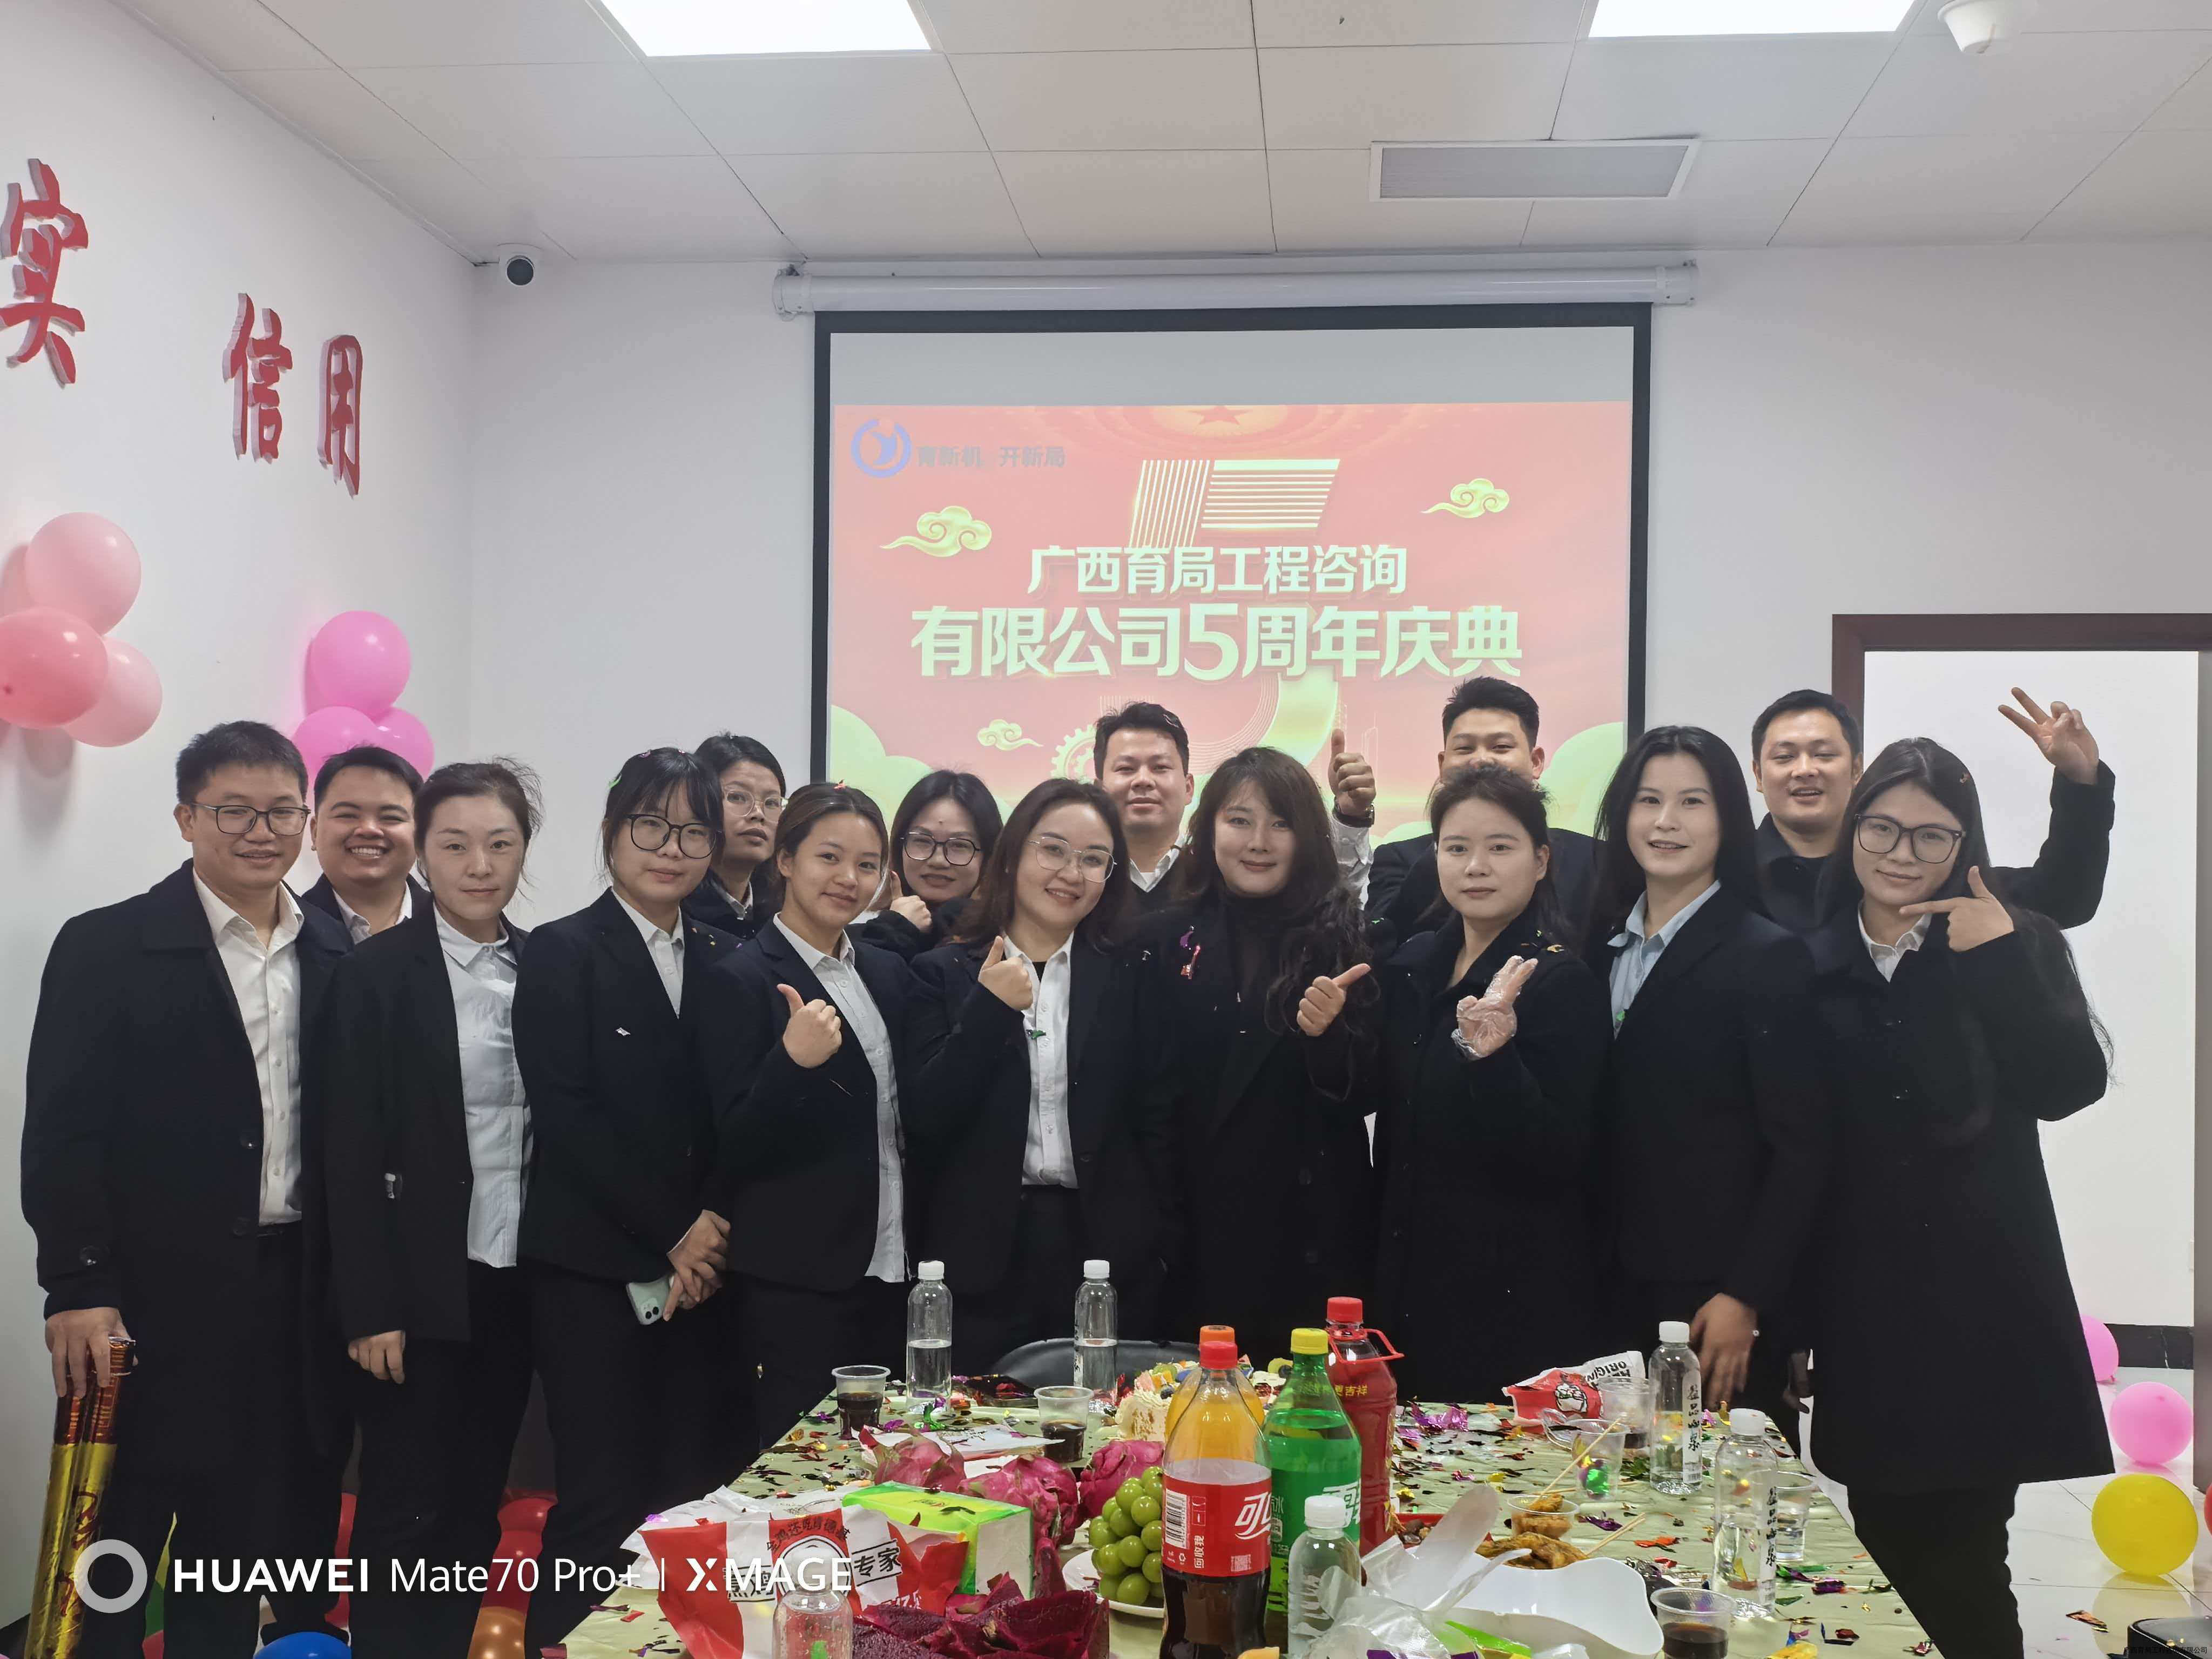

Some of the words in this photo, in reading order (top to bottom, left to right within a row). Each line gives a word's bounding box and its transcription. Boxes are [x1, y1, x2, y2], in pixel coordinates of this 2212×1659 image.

[0, 159, 88, 387] 实
[222, 293, 362, 498] 信用
[1028, 544, 1407, 594] 广西育局工程咨询
[911, 603, 1522, 680] 有限公司5周年庆典
[854, 1548, 902, 1577] 专家
[1193, 1535, 1204, 1568] 回收我
